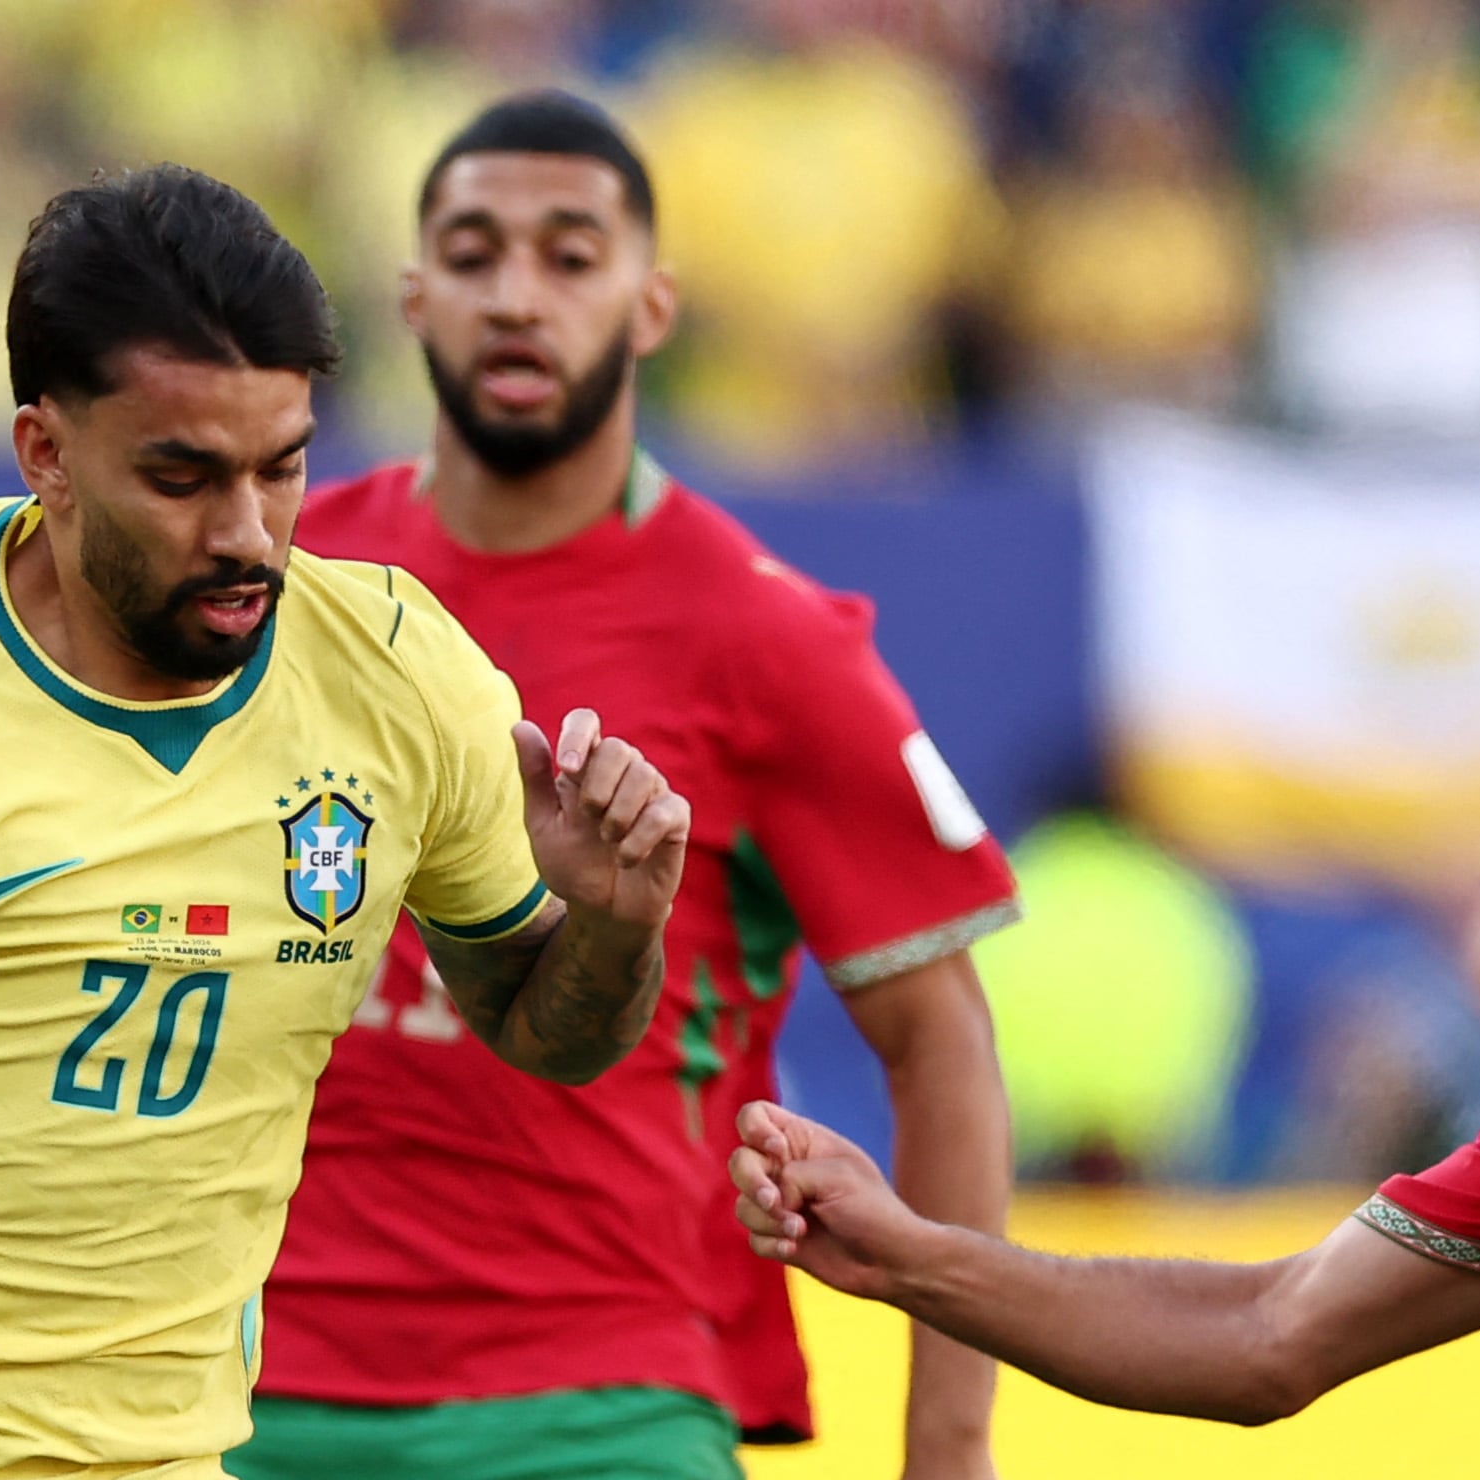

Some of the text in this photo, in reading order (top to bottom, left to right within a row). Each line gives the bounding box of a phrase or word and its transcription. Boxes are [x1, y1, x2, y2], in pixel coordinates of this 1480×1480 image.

[309, 850, 344, 867] CBF
[174, 946, 222, 957] MARROCOS
[275, 939, 354, 964] BRASIL
[51, 958, 233, 1119] 20
